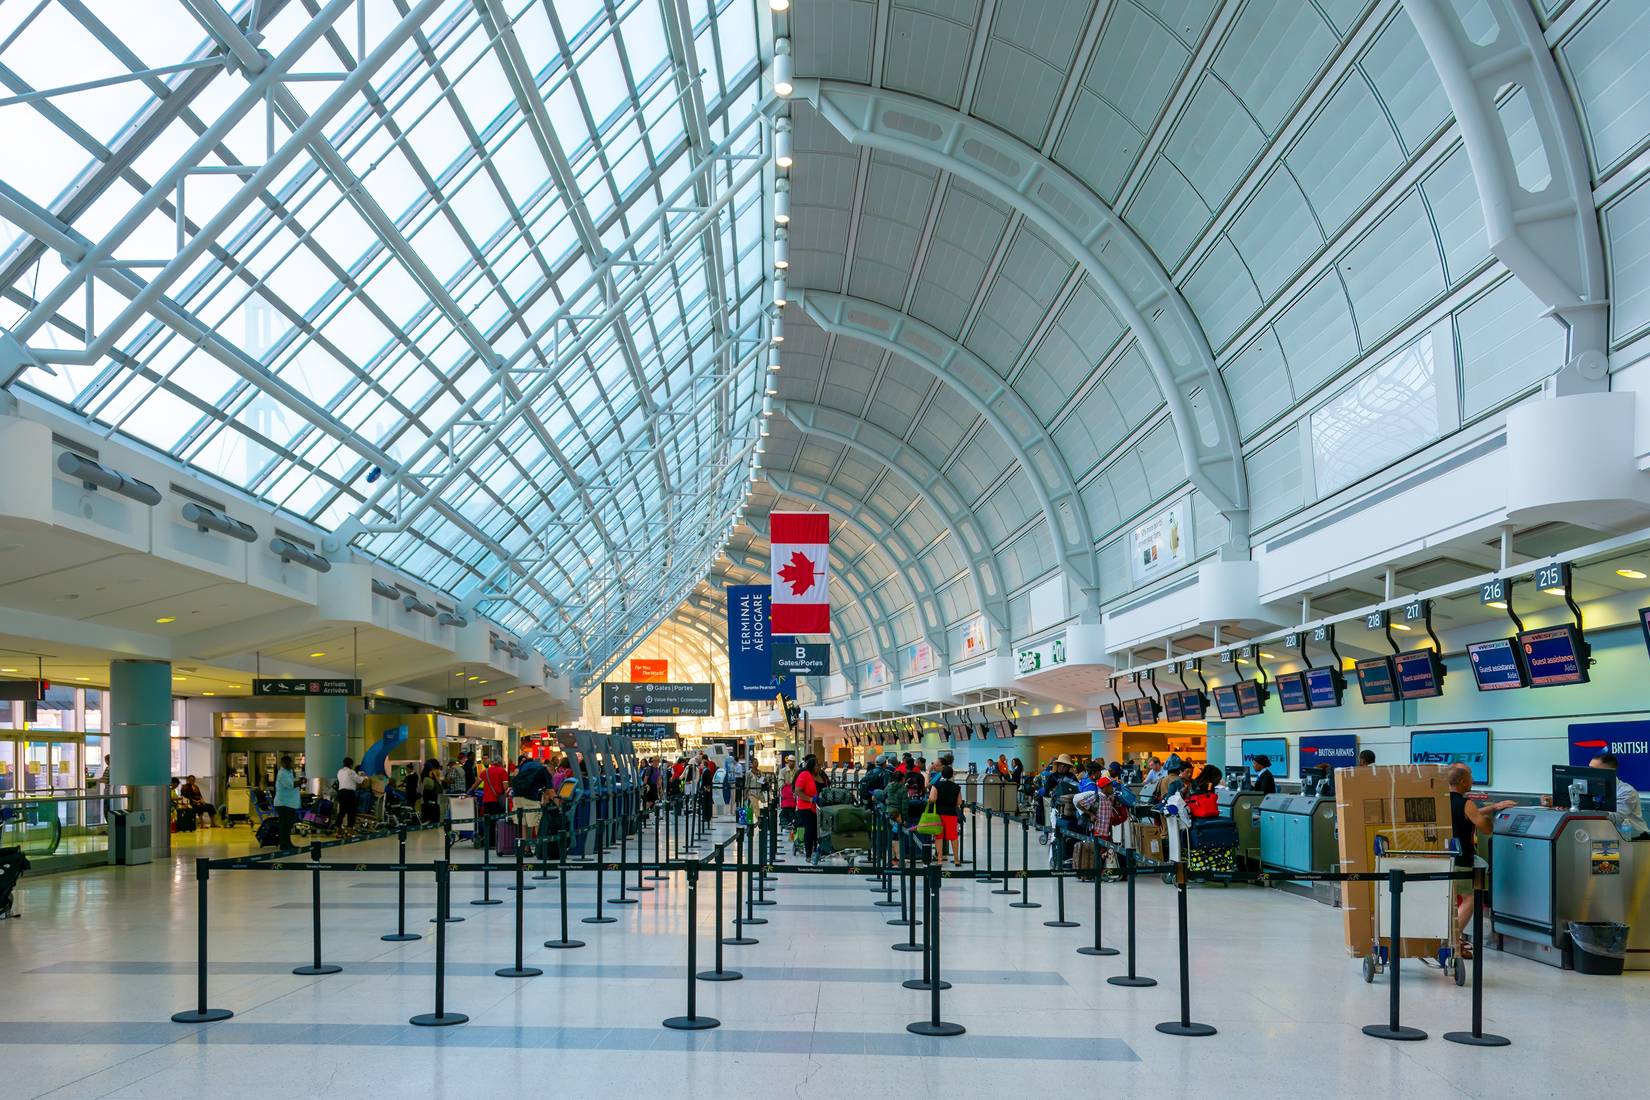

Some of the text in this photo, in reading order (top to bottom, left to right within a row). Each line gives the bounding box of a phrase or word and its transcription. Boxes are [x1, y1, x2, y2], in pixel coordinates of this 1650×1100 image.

[1540, 567, 1559, 587] 215
[1484, 583, 1501, 600] 216
[1406, 604, 1419, 619] 217
[740, 594, 751, 652] TERMINAL
[752, 594, 764, 651] AÉROGARE
[1368, 614, 1380, 628] 218
[1315, 628, 1325, 641] 219
[1286, 635, 1297, 648] 220
[795, 646, 806, 659] B
[778, 659, 823, 667] Gates/Portes
[1532, 655, 1575, 666] Guest assistance
[1479, 664, 1516, 673] Guest assistance
[1318, 748, 1354, 757] BRITISH AIRWAYS
[1611, 741, 1648, 754] BRITISH
[1412, 752, 1473, 765] WESTJET
